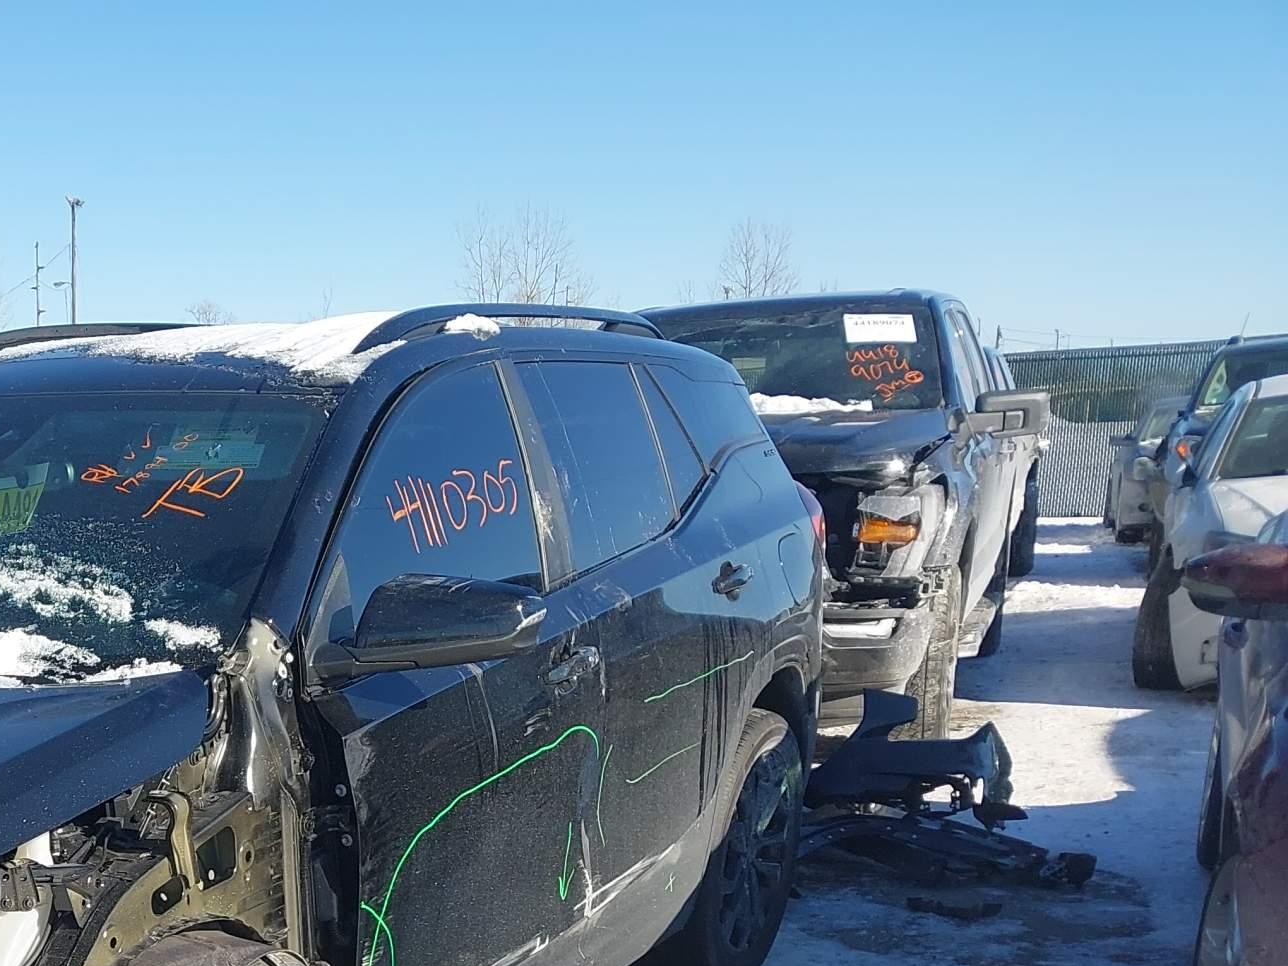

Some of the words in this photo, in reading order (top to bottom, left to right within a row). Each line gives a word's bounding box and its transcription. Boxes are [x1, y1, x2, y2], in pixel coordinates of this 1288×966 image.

[845, 343, 899, 363] 4418
[850, 358, 911, 381] 9074
[385, 458, 518, 554] 44110305
